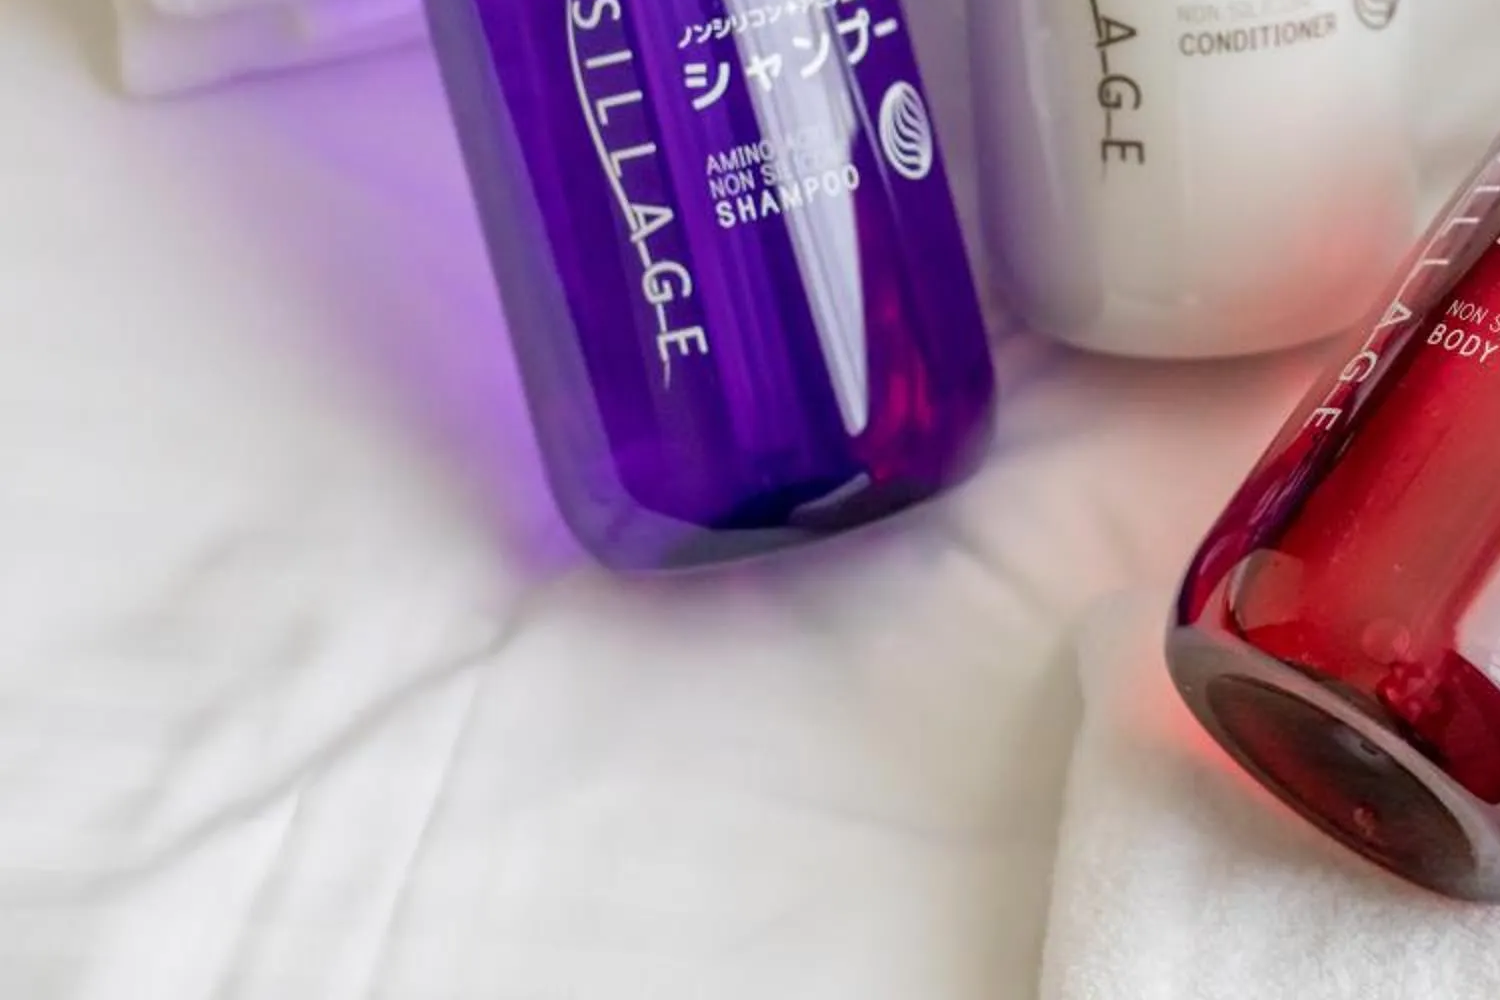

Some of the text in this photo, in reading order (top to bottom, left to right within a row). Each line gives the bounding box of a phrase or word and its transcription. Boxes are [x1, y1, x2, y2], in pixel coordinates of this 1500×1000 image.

[1179, 11, 1338, 57] CONDITIONER
[684, 8, 897, 110] シャンプー
[706, 139, 775, 177] AMINO
[708, 168, 756, 199] NON
[715, 163, 860, 229] SHAMPOO
[1446, 300, 1488, 325] NON
[1427, 323, 1500, 363] BODY
